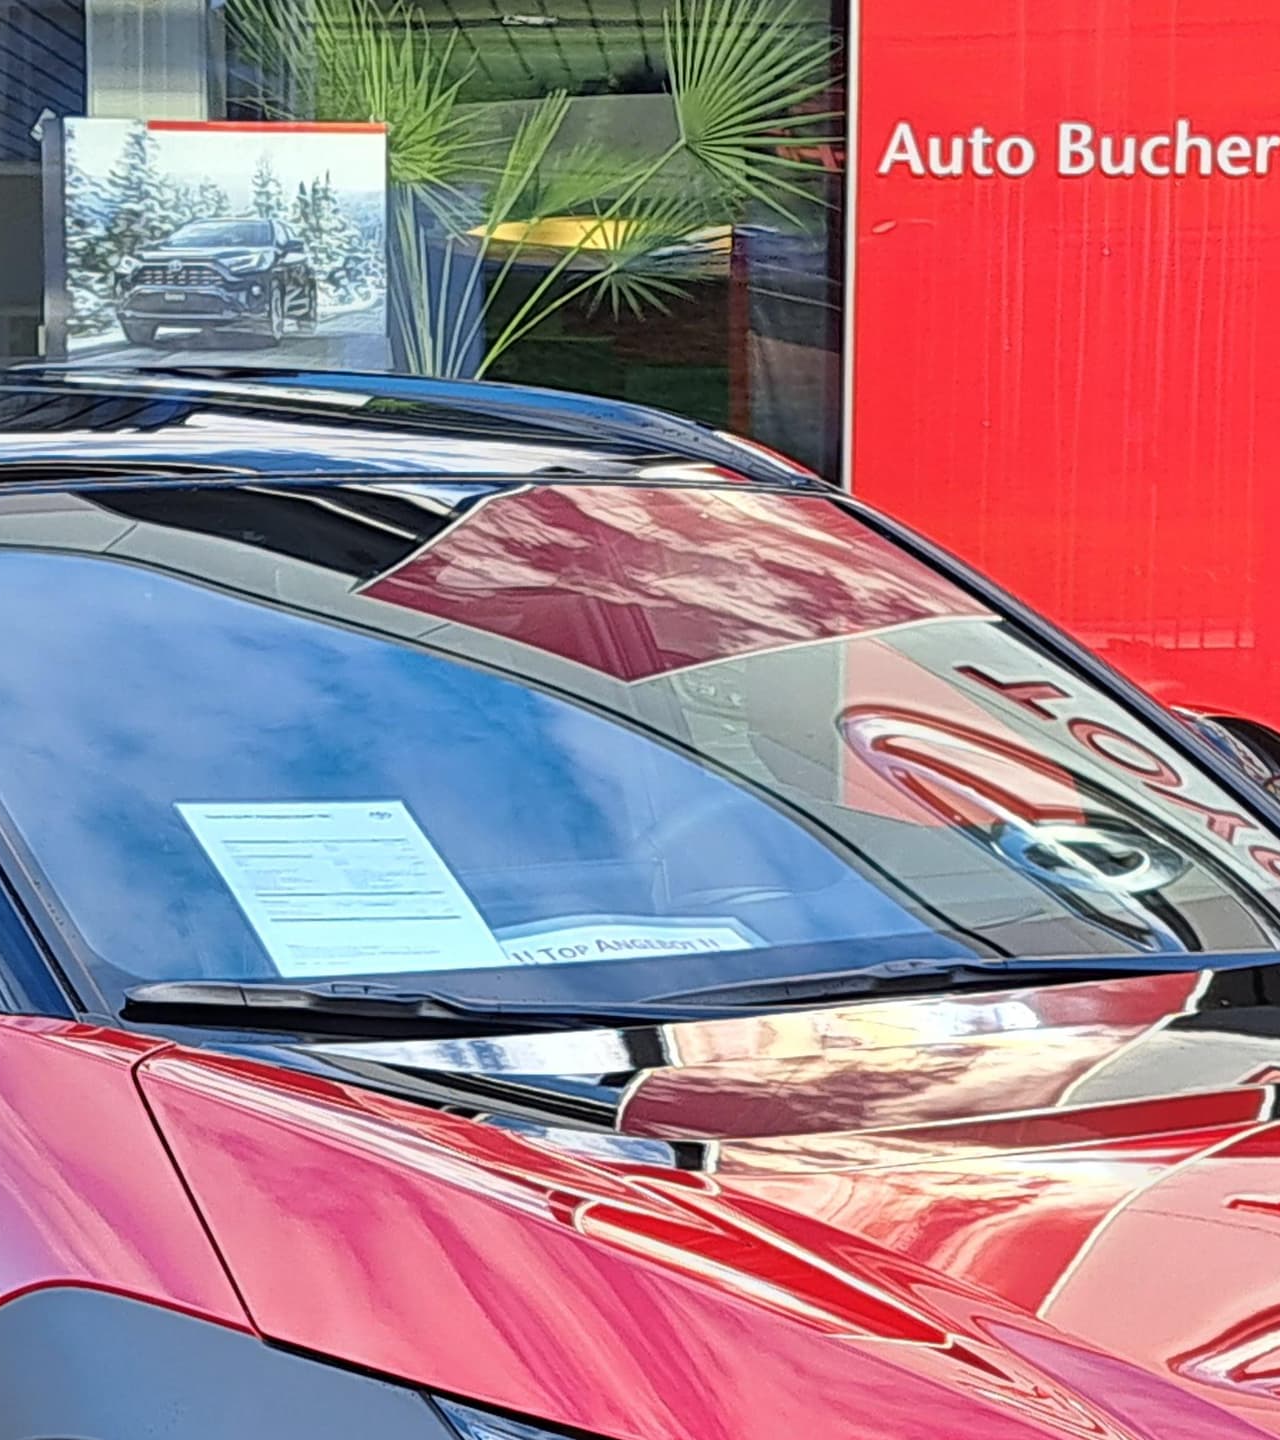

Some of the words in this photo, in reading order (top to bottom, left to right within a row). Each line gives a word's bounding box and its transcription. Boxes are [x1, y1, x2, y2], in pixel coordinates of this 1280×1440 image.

[878, 121, 1035, 177] Auto
[1057, 119, 1280, 176] Bucher
[537, 944, 589, 962] TOP
